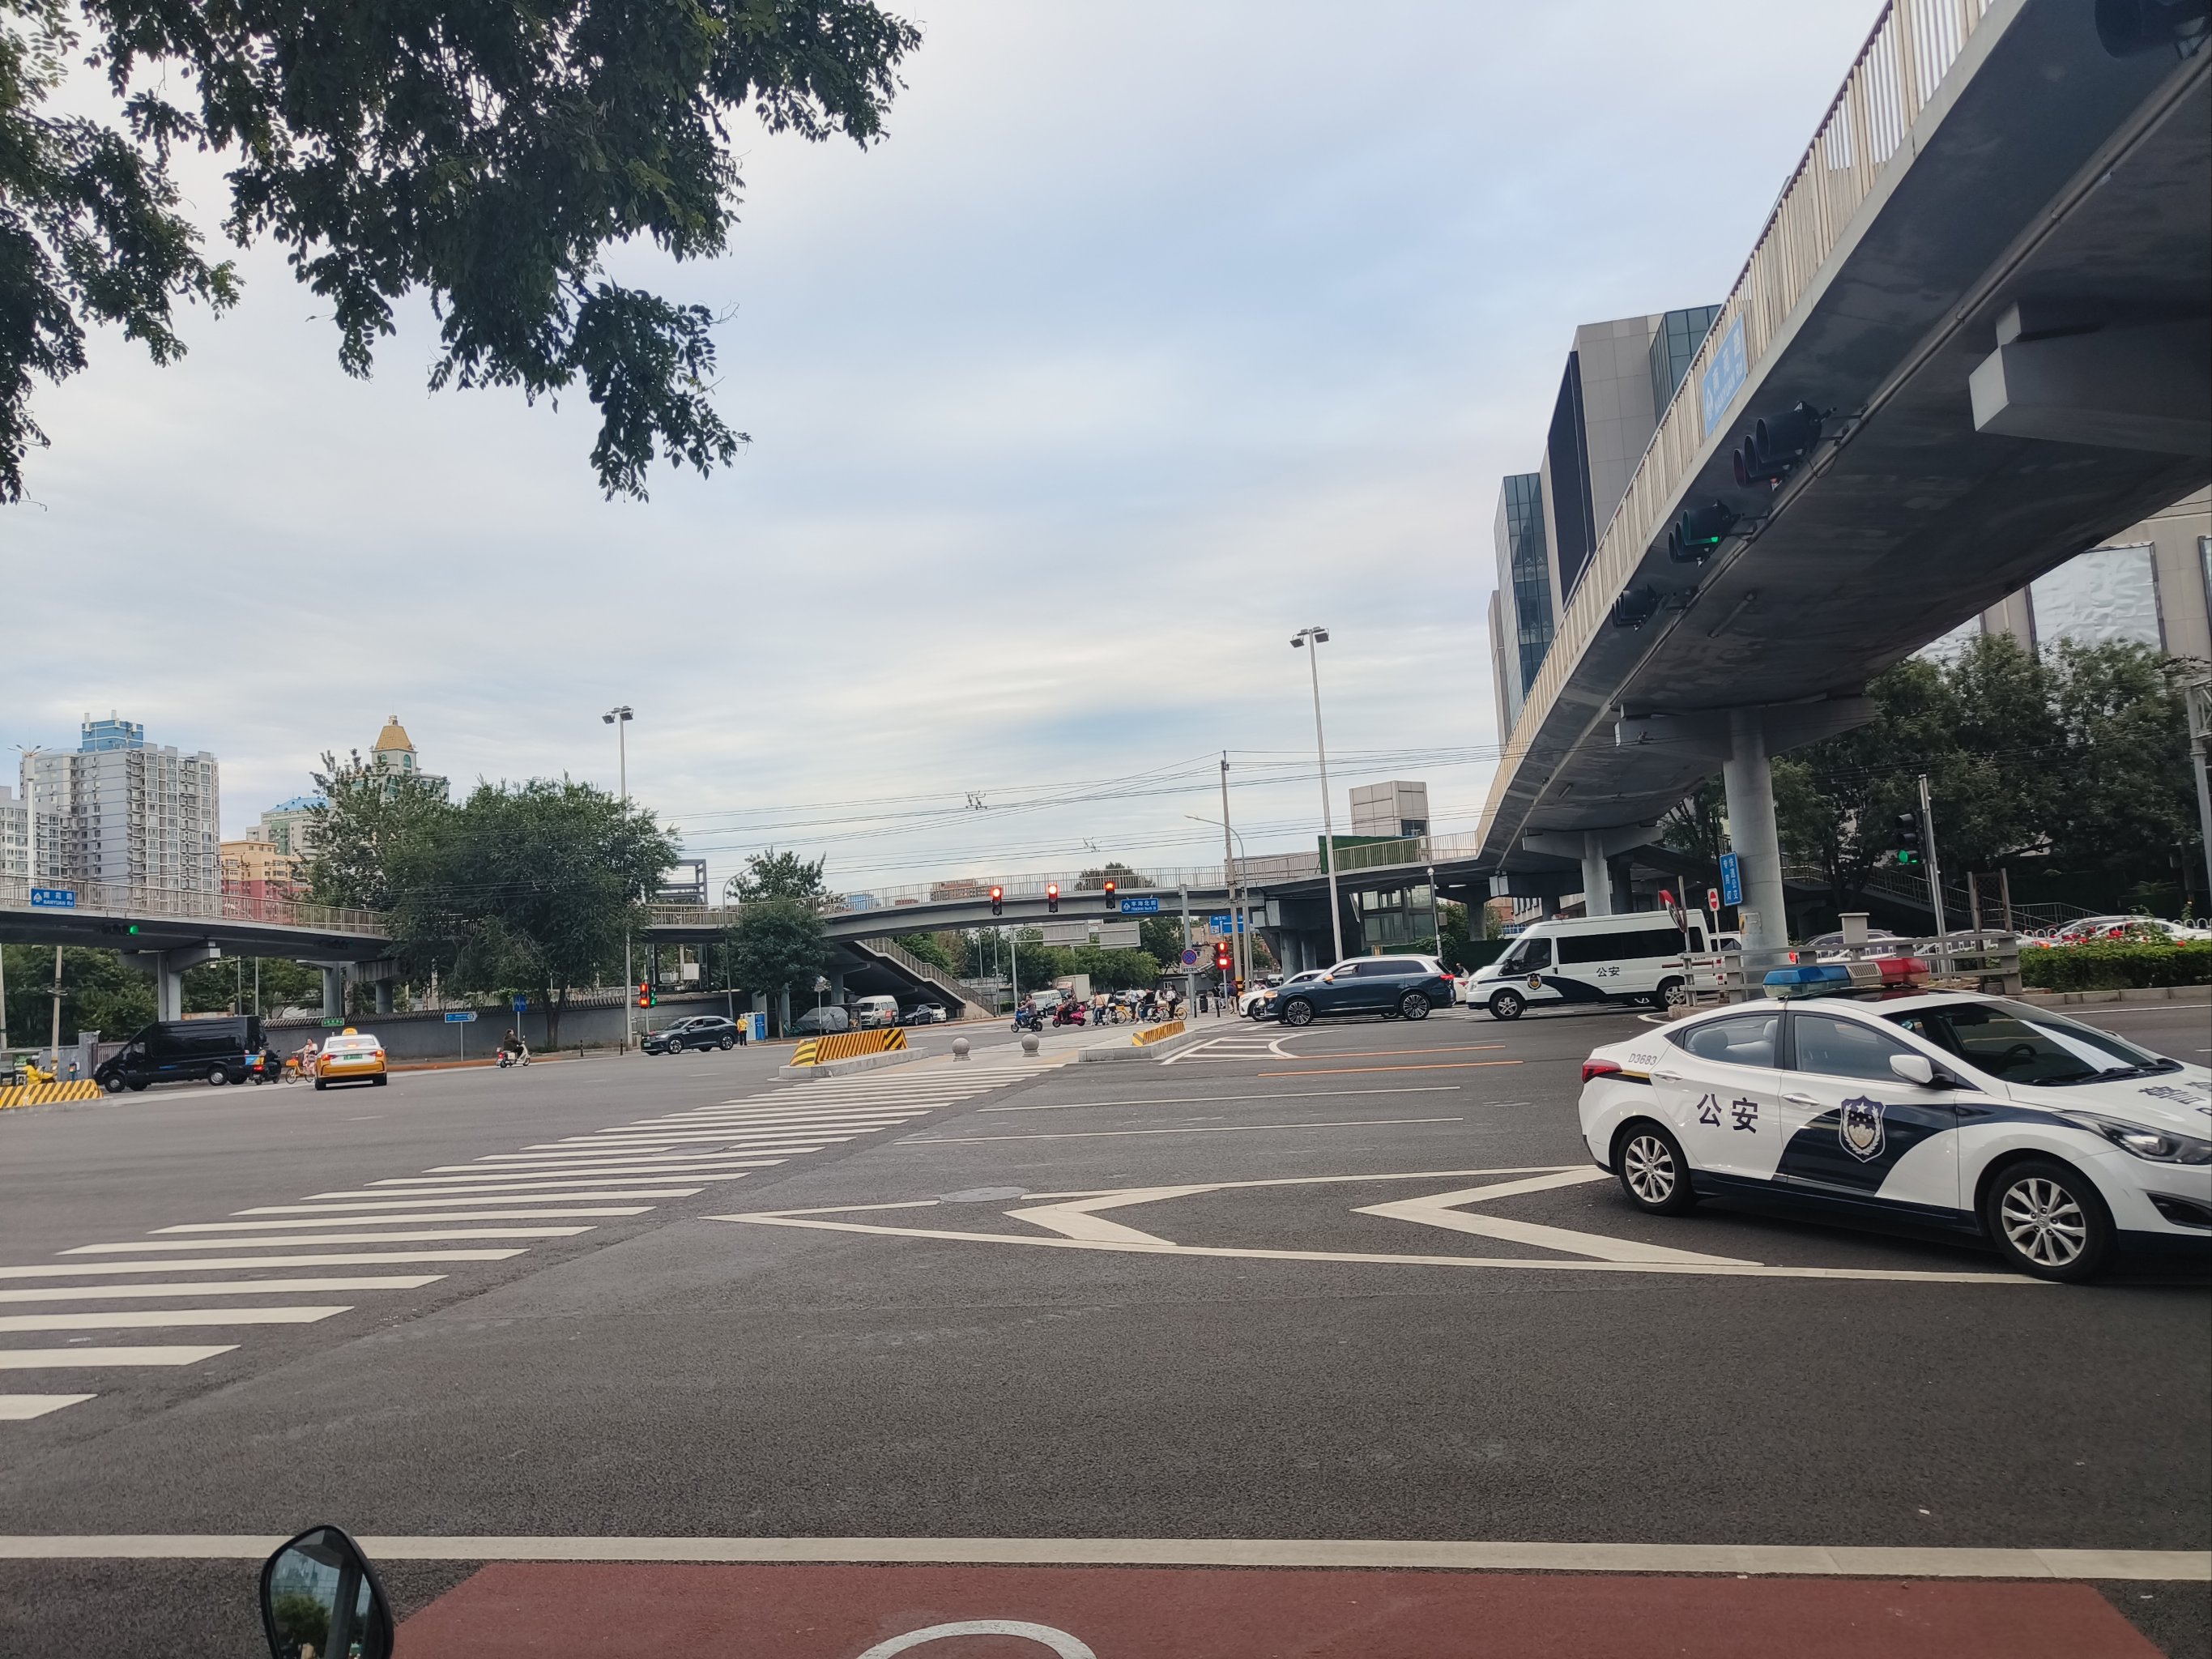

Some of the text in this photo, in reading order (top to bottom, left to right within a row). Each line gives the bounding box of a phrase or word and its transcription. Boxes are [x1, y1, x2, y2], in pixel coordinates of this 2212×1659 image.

[1723, 859, 1732, 901] 专用灯
[1728, 857, 1738, 900] 快速公交
[1596, 966, 1620, 977] 公安
[1628, 1053, 1657, 1065] D3683
[1696, 1094, 1758, 1134] 公安
